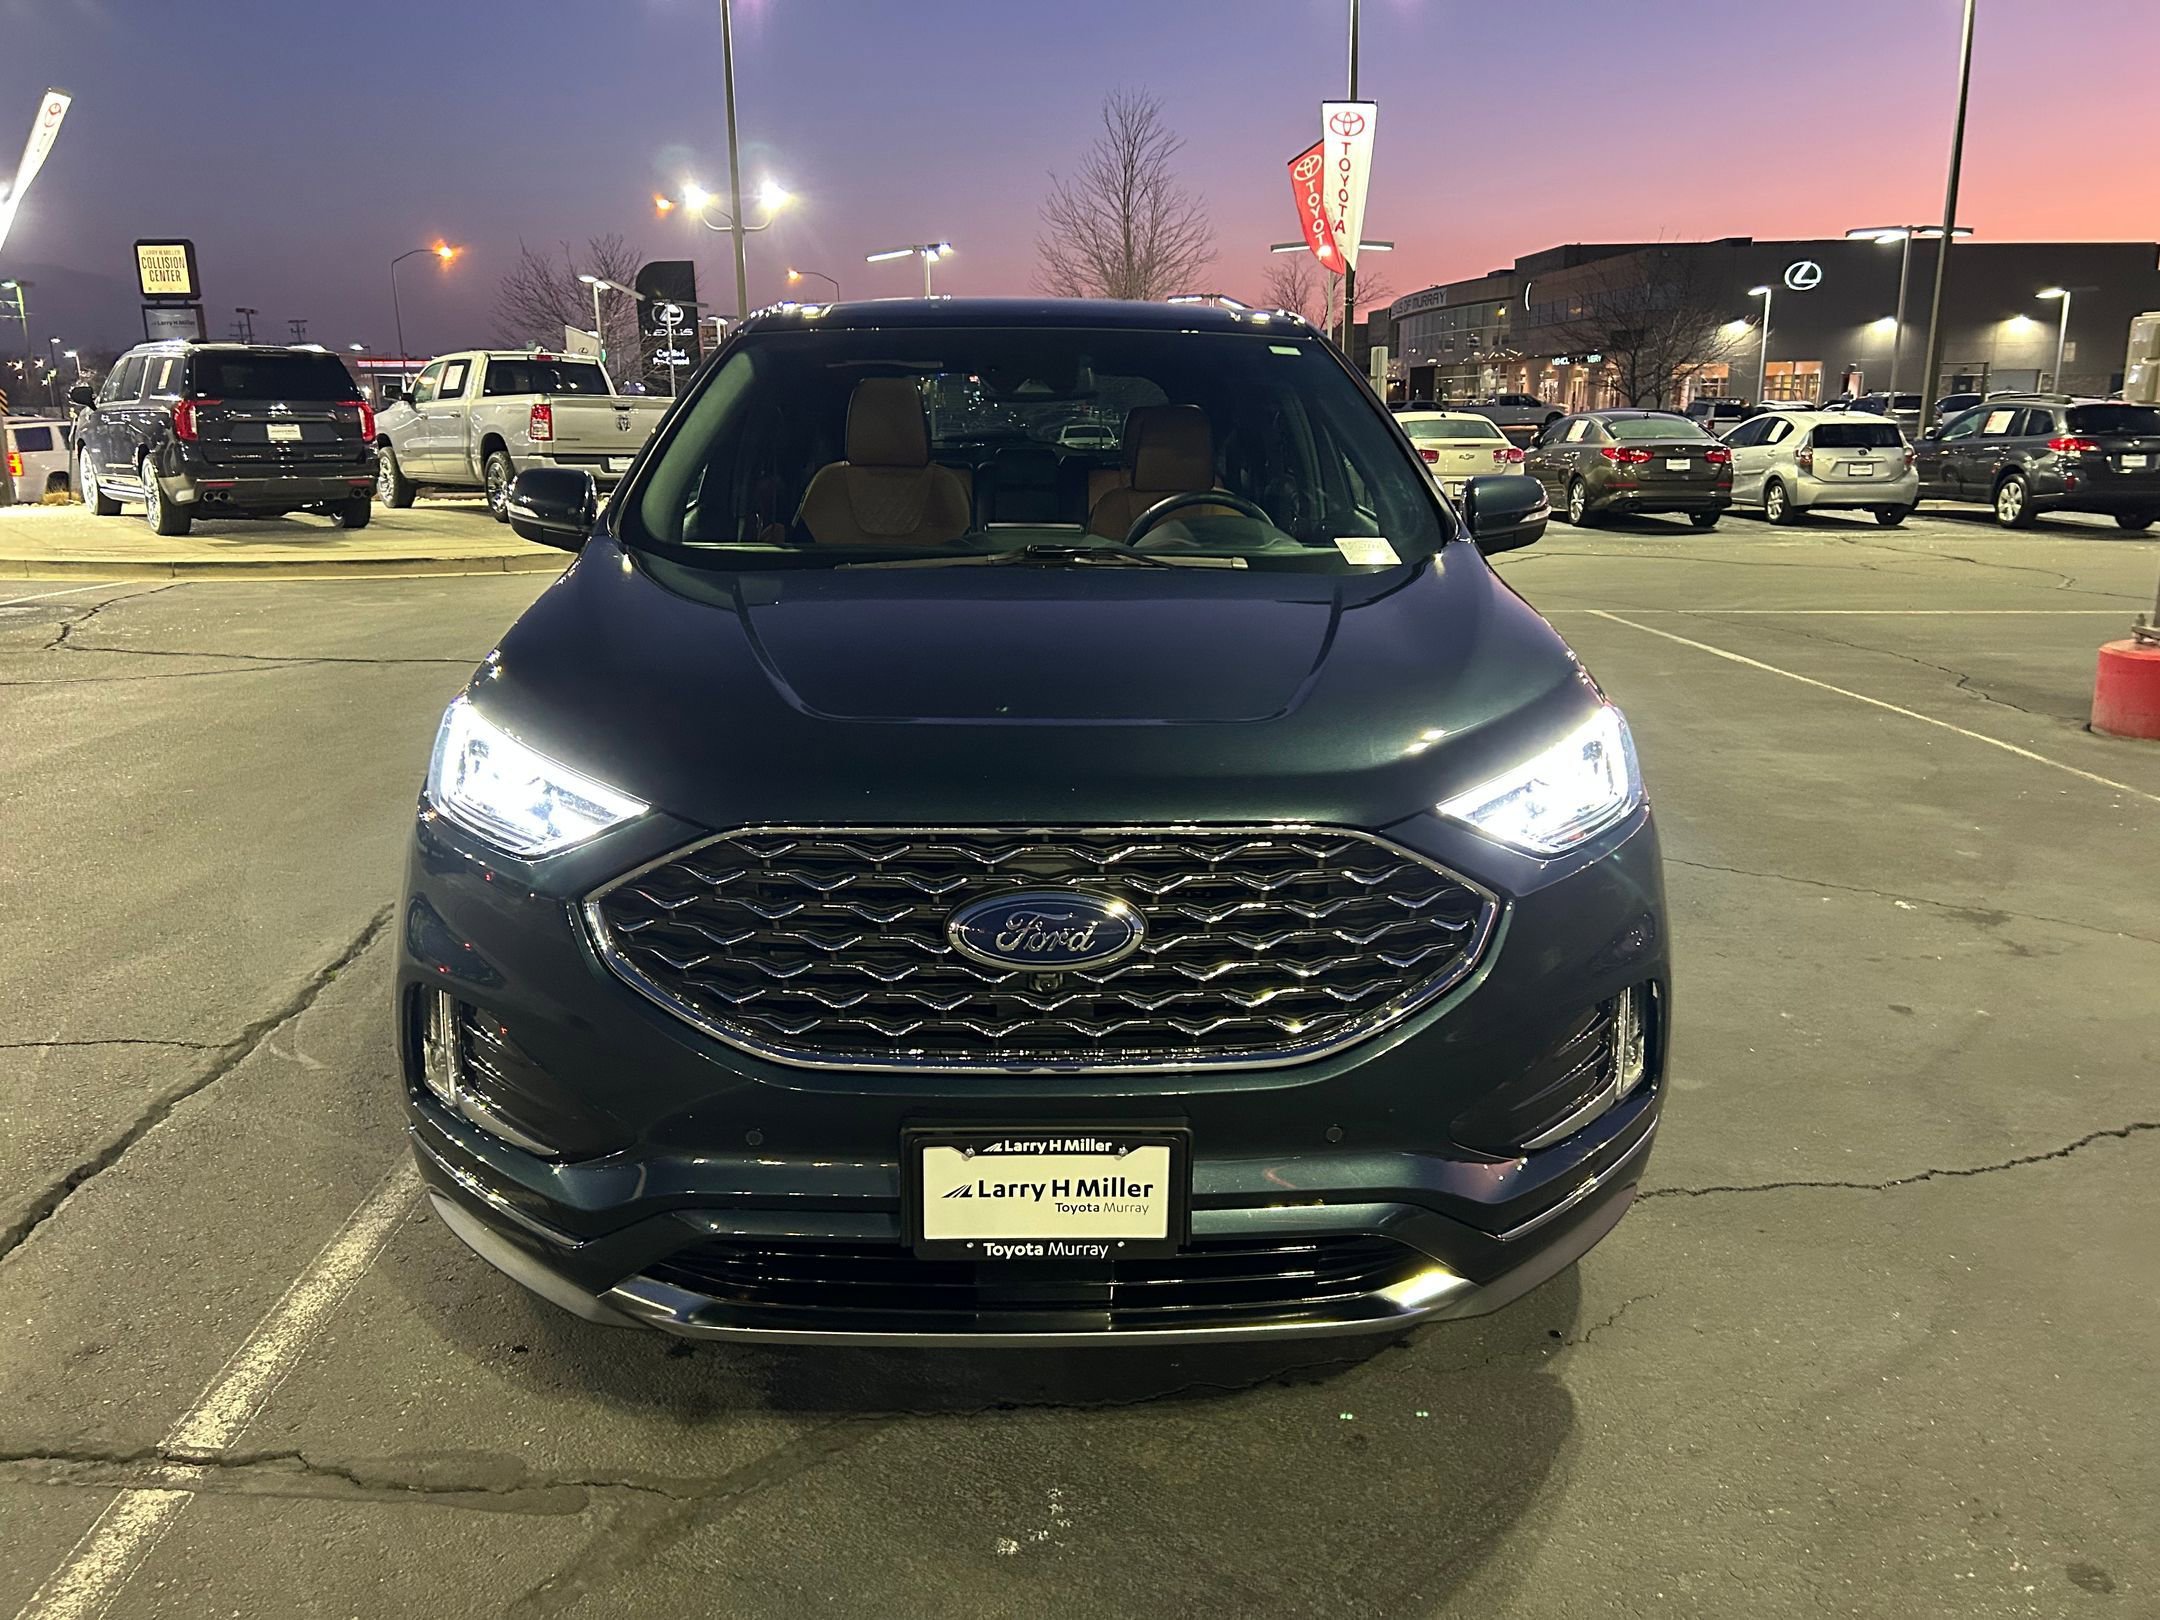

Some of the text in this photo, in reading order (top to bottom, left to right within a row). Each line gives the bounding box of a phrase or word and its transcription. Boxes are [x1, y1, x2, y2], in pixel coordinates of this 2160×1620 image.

[1334, 142, 1351, 234] TOYOTA
[141, 256, 185, 269] COLLISION
[149, 269, 182, 282] CENTER
[1412, 292, 1447, 309] MURRAY
[995, 910, 1100, 953] Ford
[1004, 1138, 1112, 1155] Larry H Miller
[978, 1177, 1154, 1202] Larry H Miller
[1055, 1202, 1150, 1215] Toyota Murray
[983, 1241, 1109, 1260] Toyota Murray
